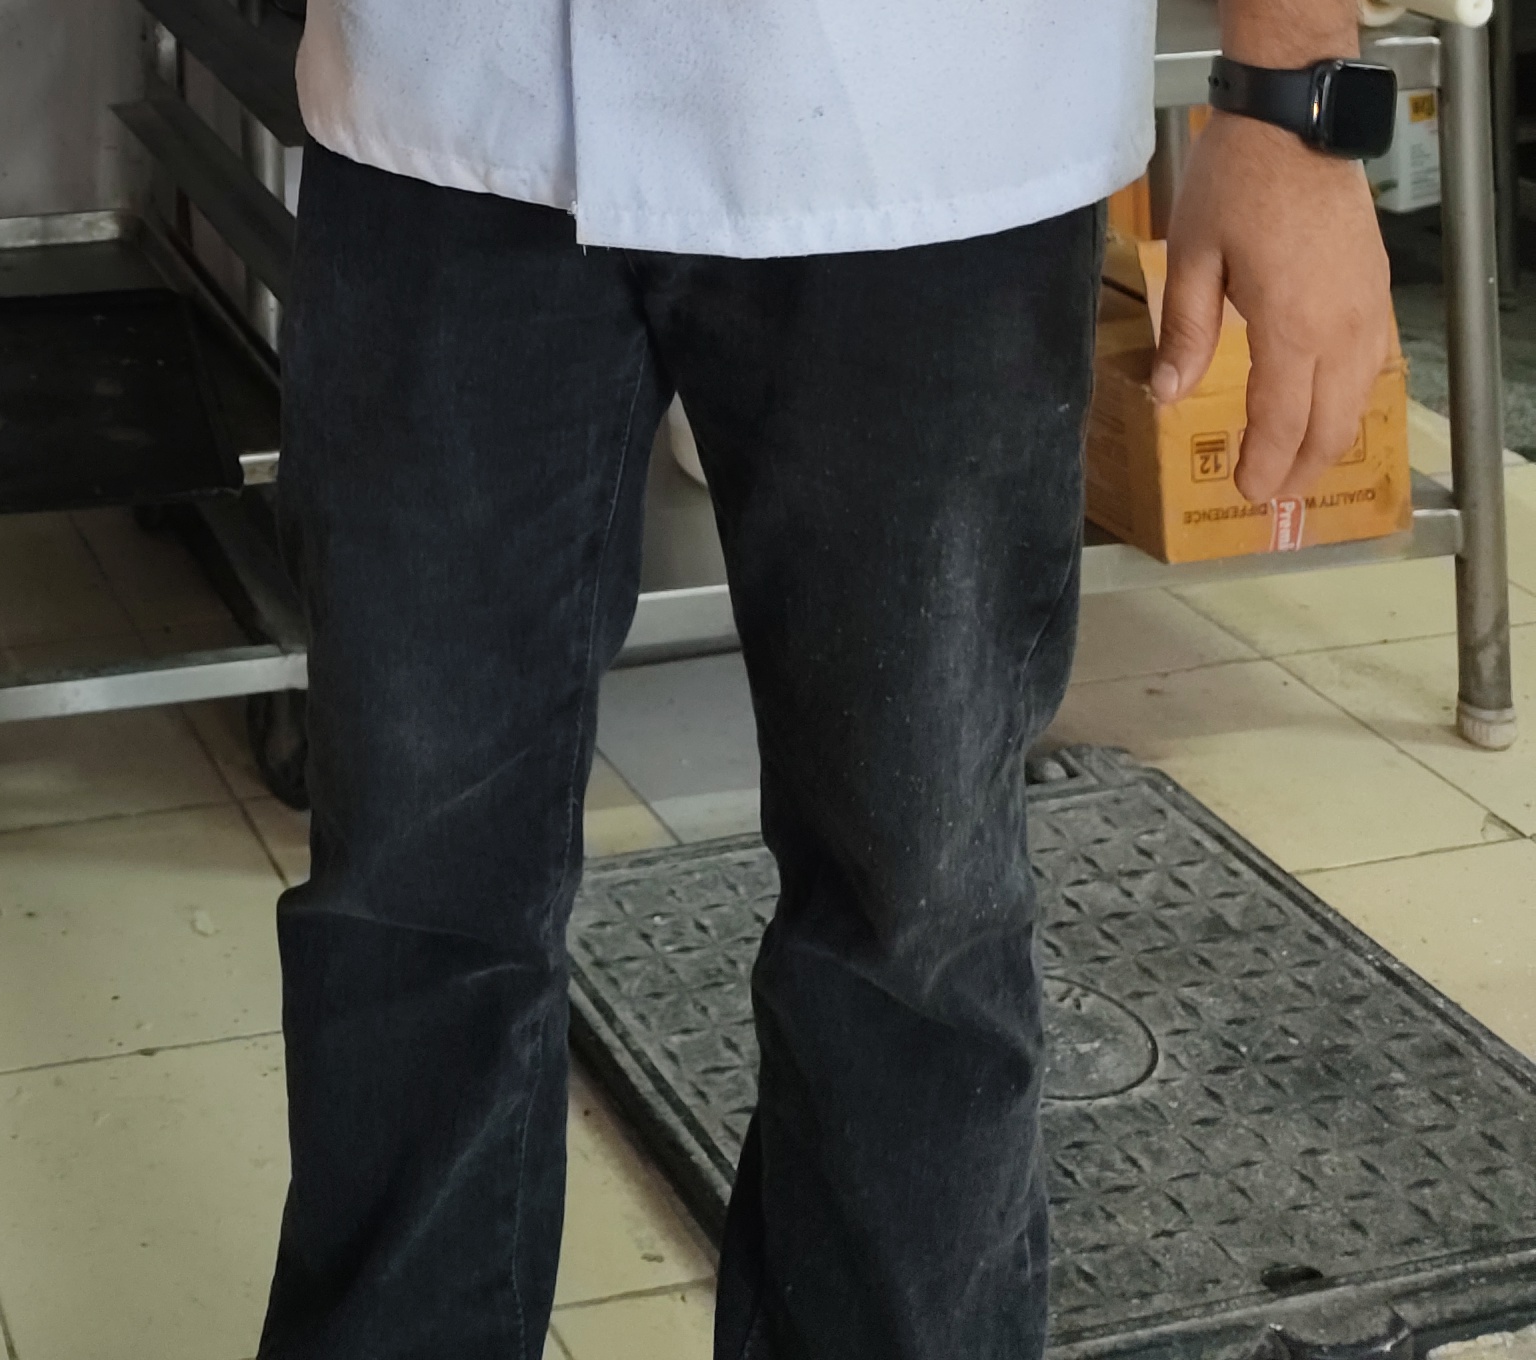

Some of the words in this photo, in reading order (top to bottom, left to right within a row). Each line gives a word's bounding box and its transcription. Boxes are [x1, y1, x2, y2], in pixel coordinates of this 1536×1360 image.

[1199, 452, 1222, 474] 12
[1319, 487, 1376, 508] QUALITY
[1183, 502, 1268, 525] DIFFERENCE
